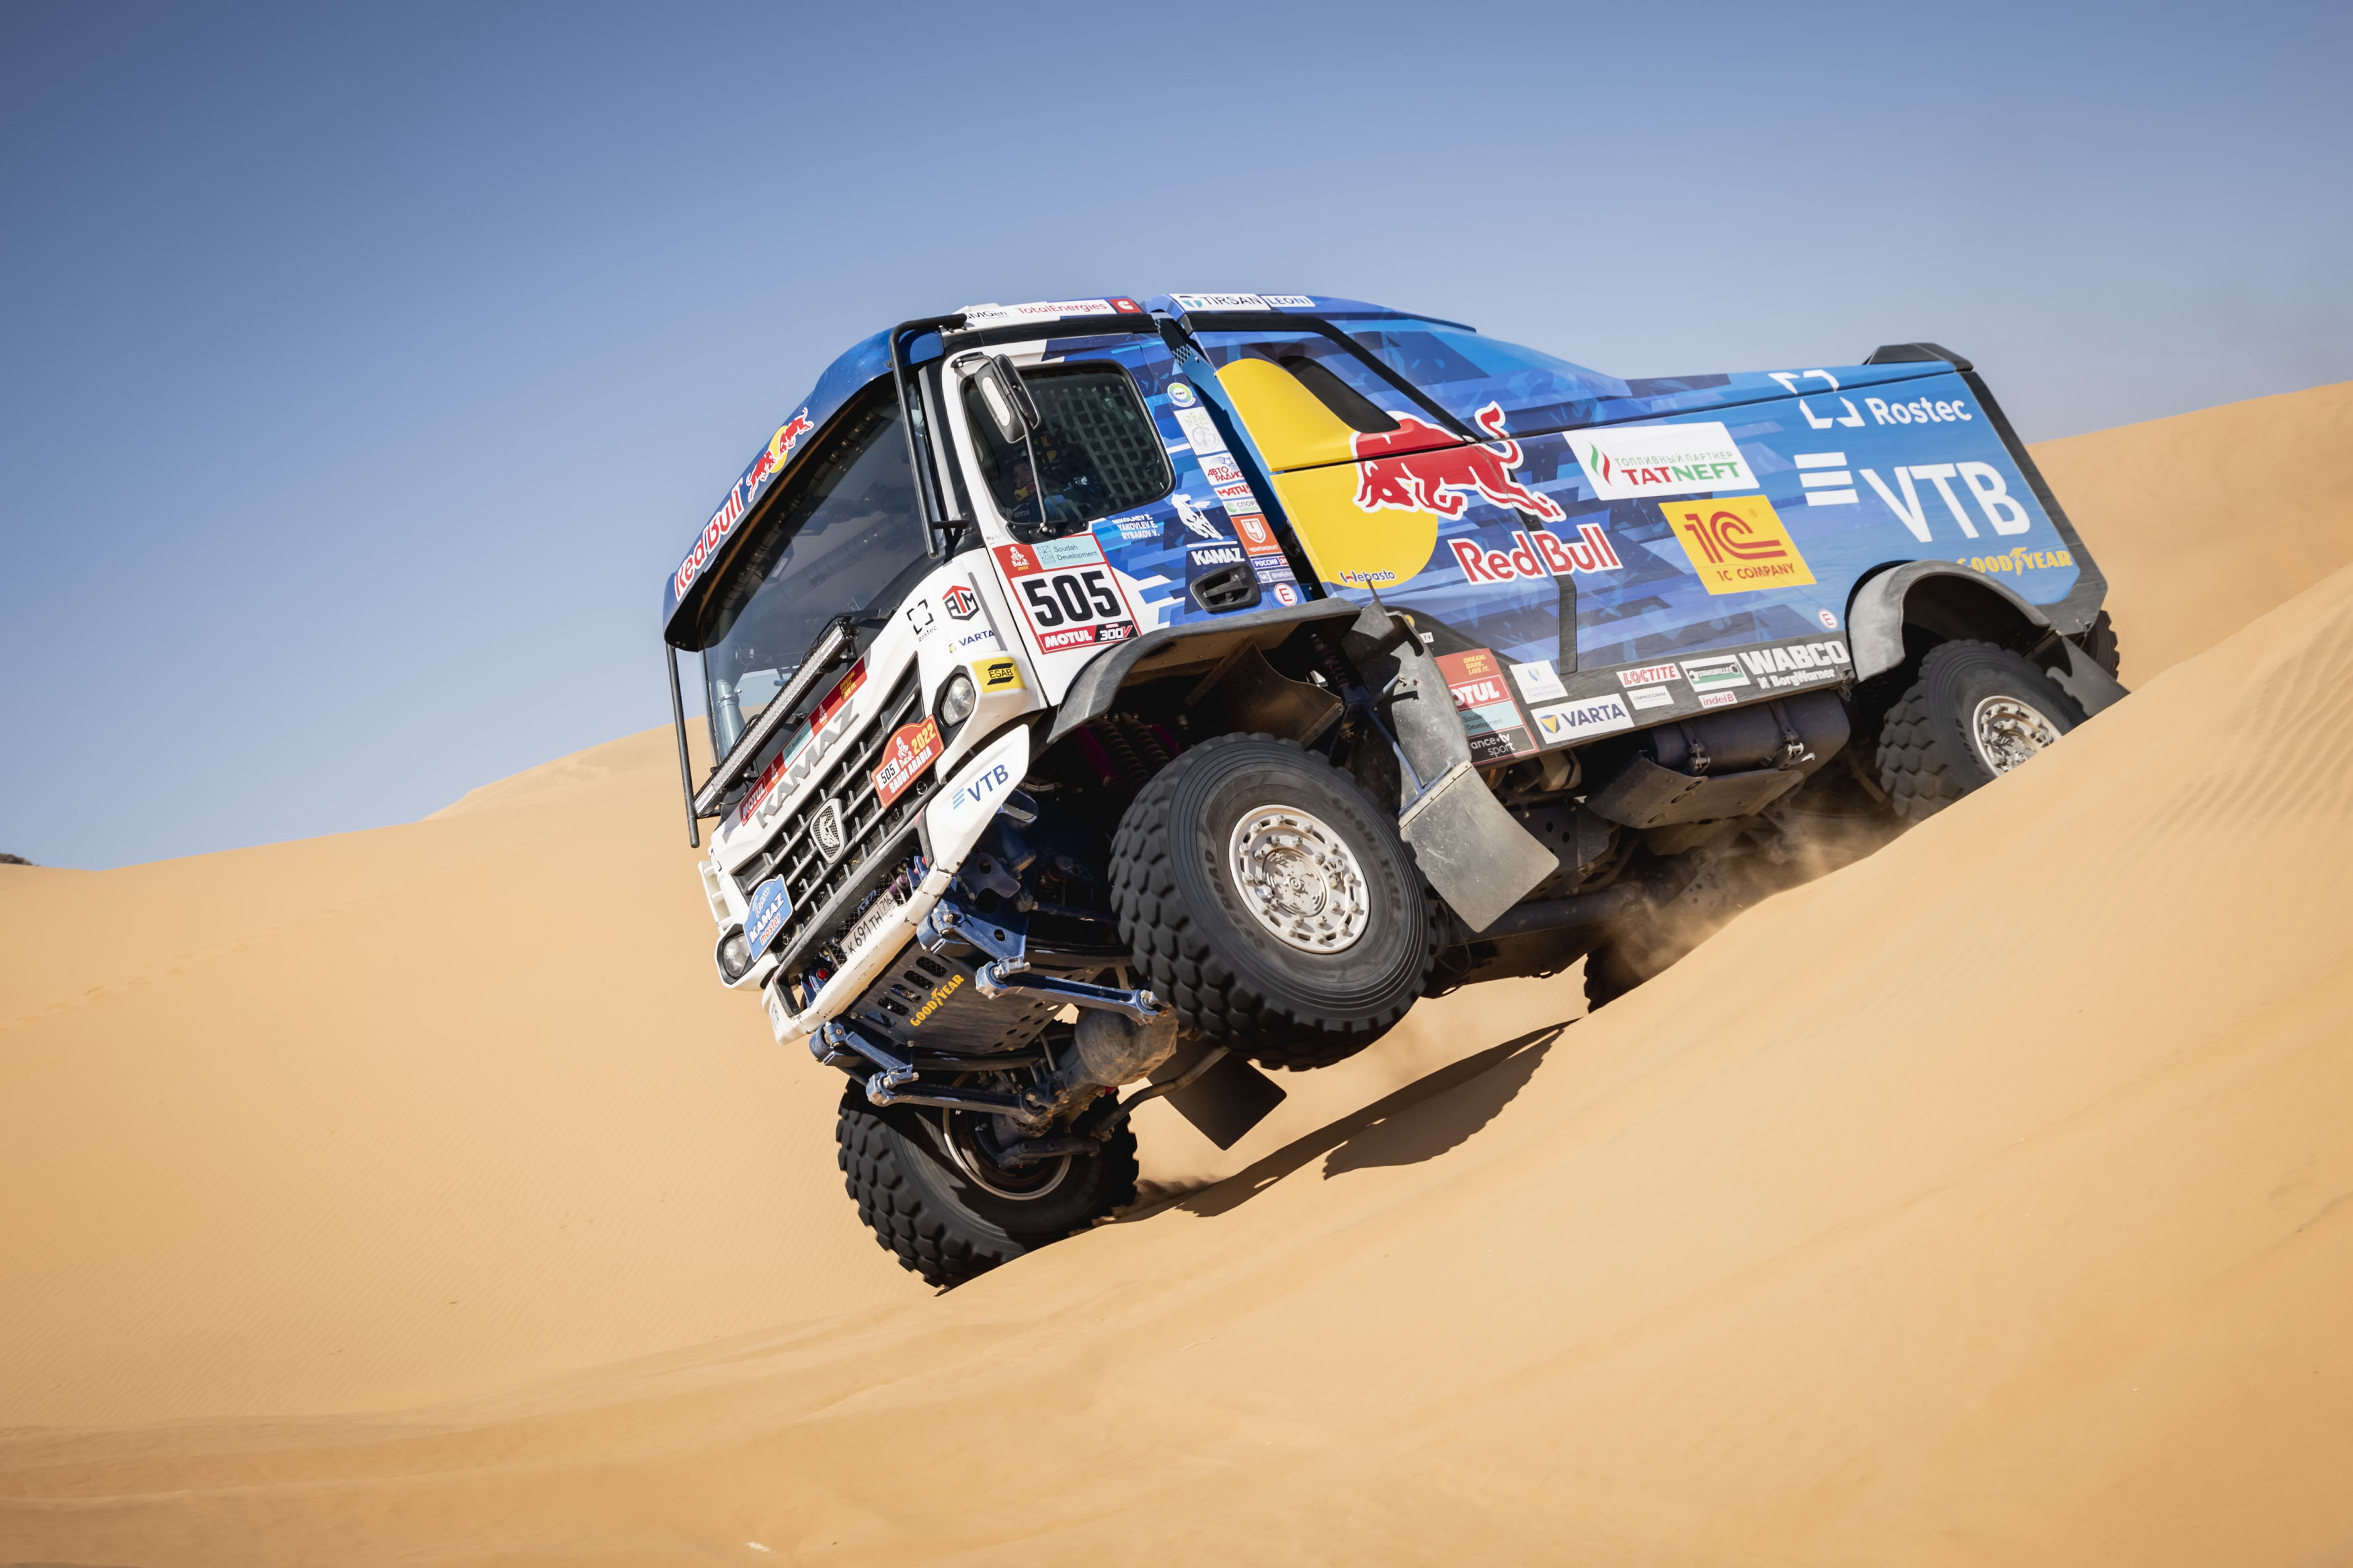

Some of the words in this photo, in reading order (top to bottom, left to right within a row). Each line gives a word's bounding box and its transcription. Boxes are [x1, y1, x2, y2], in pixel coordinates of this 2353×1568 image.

[1017, 302, 1107, 315] TotalEnergies
[1865, 397, 1972, 425] Rostec
[1614, 452, 1683, 467] ТОПЛИВНЫЙ
[1685, 451, 1733, 463] ПАРТНЕР
[1207, 466, 1229, 477] АВТО
[1215, 470, 1244, 482] РАДИО
[1621, 462, 1740, 486] TATNEFT
[1859, 461, 2030, 543] VTB
[705, 477, 744, 554] Bull
[1117, 521, 1150, 532] YAKOVLEV
[1121, 530, 1152, 540] RYBAKOV
[1151, 529, 1160, 537] V.
[1053, 544, 1079, 552] Soudah
[1057, 550, 1099, 561] Development
[1191, 548, 1246, 565] KAMAZ
[1451, 534, 1544, 583] Red
[1533, 526, 1620, 573] Bull
[1254, 558, 1279, 567] РОССИЯ
[1716, 569, 1733, 581] 1C
[1737, 563, 1795, 579] COMPANY
[1339, 569, 1395, 583] Webasto
[1021, 570, 1121, 627] 505
[1279, 587, 1293, 602] E
[918, 625, 938, 643] Rostec
[958, 630, 996, 647] VARTA
[1045, 629, 1092, 649] MOTUL
[1099, 624, 1133, 641] 300V
[1463, 653, 1488, 664] DREAM.
[1739, 641, 1851, 675] WABCO
[988, 668, 1014, 678] ESAB
[1468, 667, 1482, 675] LIVE
[1622, 665, 1676, 686] LOCTITE
[1769, 668, 1835, 687] BorgWarner
[1449, 681, 1501, 706] OTUL
[1560, 703, 1627, 727] VARTA
[911, 722, 936, 755] 2022
[1487, 742, 1516, 758] sport
[755, 698, 859, 829] KAMAZ
[888, 768, 910, 794] SAUDI
[909, 745, 933, 776] ARABIA
[880, 763, 896, 784] 505
[966, 764, 1010, 802] VTB
[742, 785, 766, 819] MOTUL
[748, 891, 785, 945] KAMAZ
[854, 923, 873, 948] 691
[879, 895, 894, 911] 716
[760, 912, 781, 946] master
[910, 973, 966, 1027] GOODYEAR
